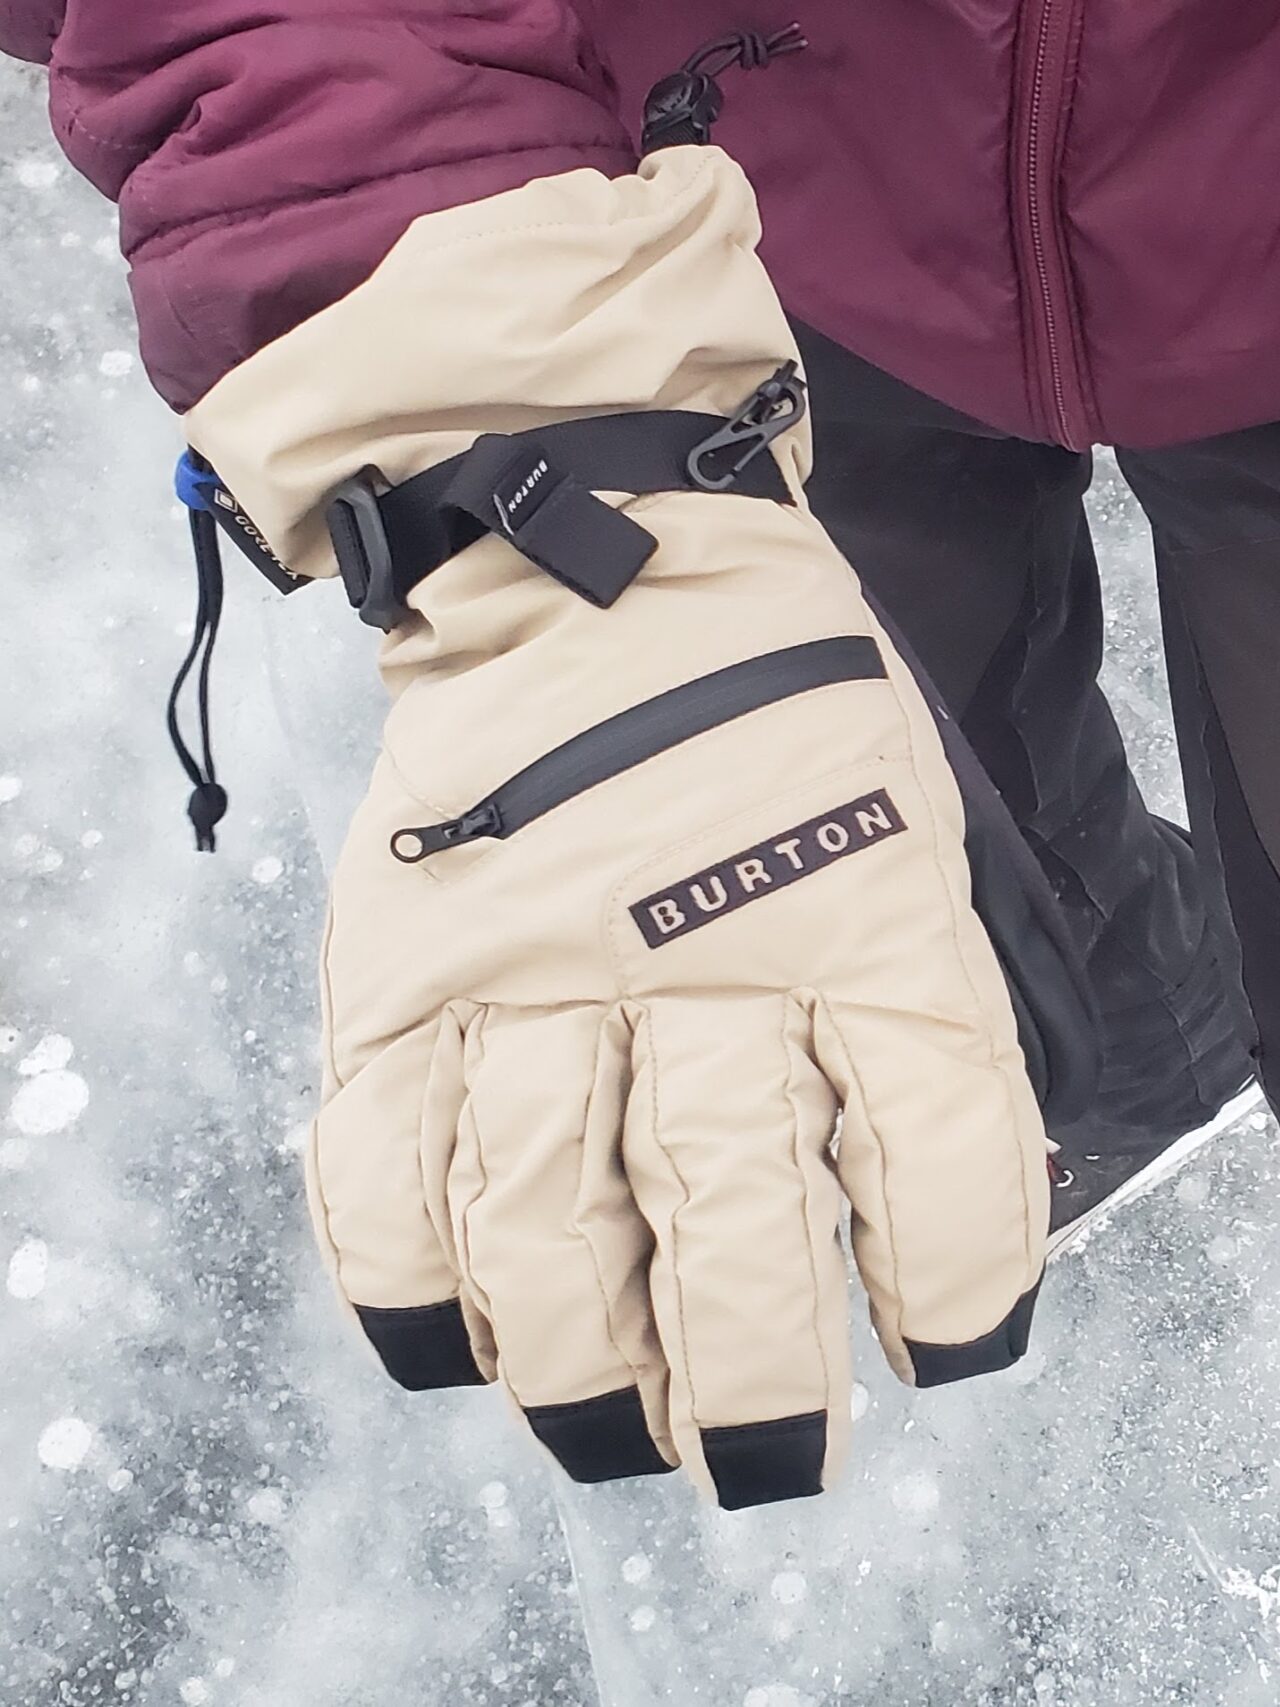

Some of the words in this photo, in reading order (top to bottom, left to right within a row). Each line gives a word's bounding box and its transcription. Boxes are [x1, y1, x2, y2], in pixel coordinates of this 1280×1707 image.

[508, 459, 548, 513] BURTON
[235, 515, 298, 581] GOREX
[648, 802, 893, 935] BURTON
